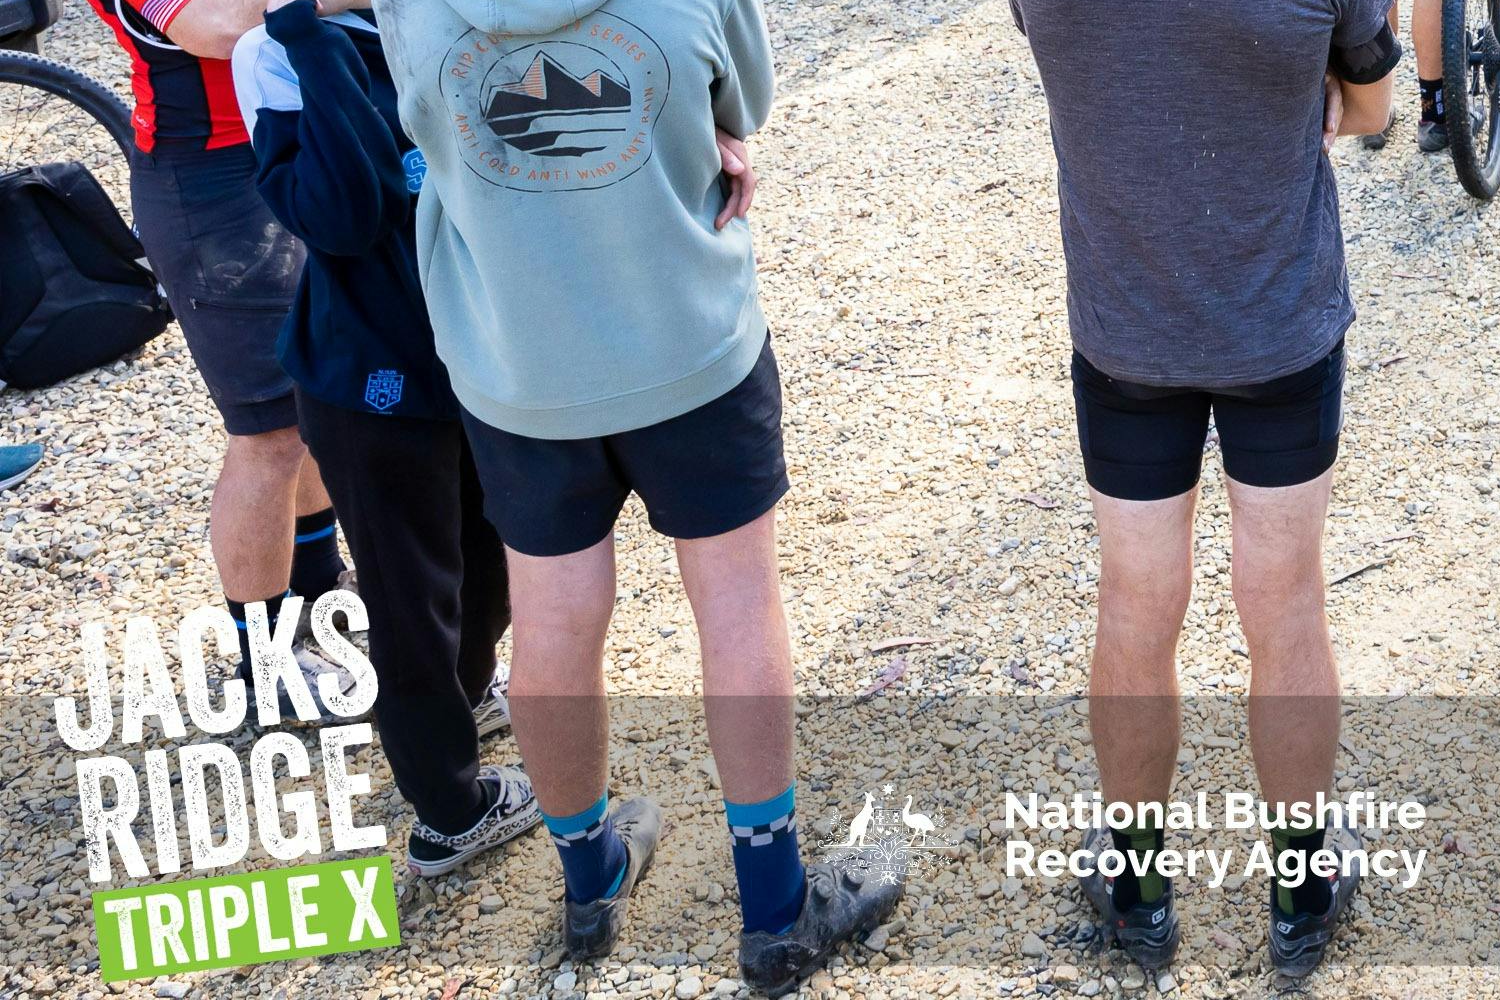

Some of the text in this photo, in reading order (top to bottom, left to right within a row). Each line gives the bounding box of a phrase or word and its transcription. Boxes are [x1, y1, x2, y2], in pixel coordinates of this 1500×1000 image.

[589, 24, 647, 64] SERIES
[450, 52, 475, 80] RIP
[527, 169, 570, 181] ANTI
[577, 161, 617, 181] WIND
[620, 130, 648, 163] ANTI
